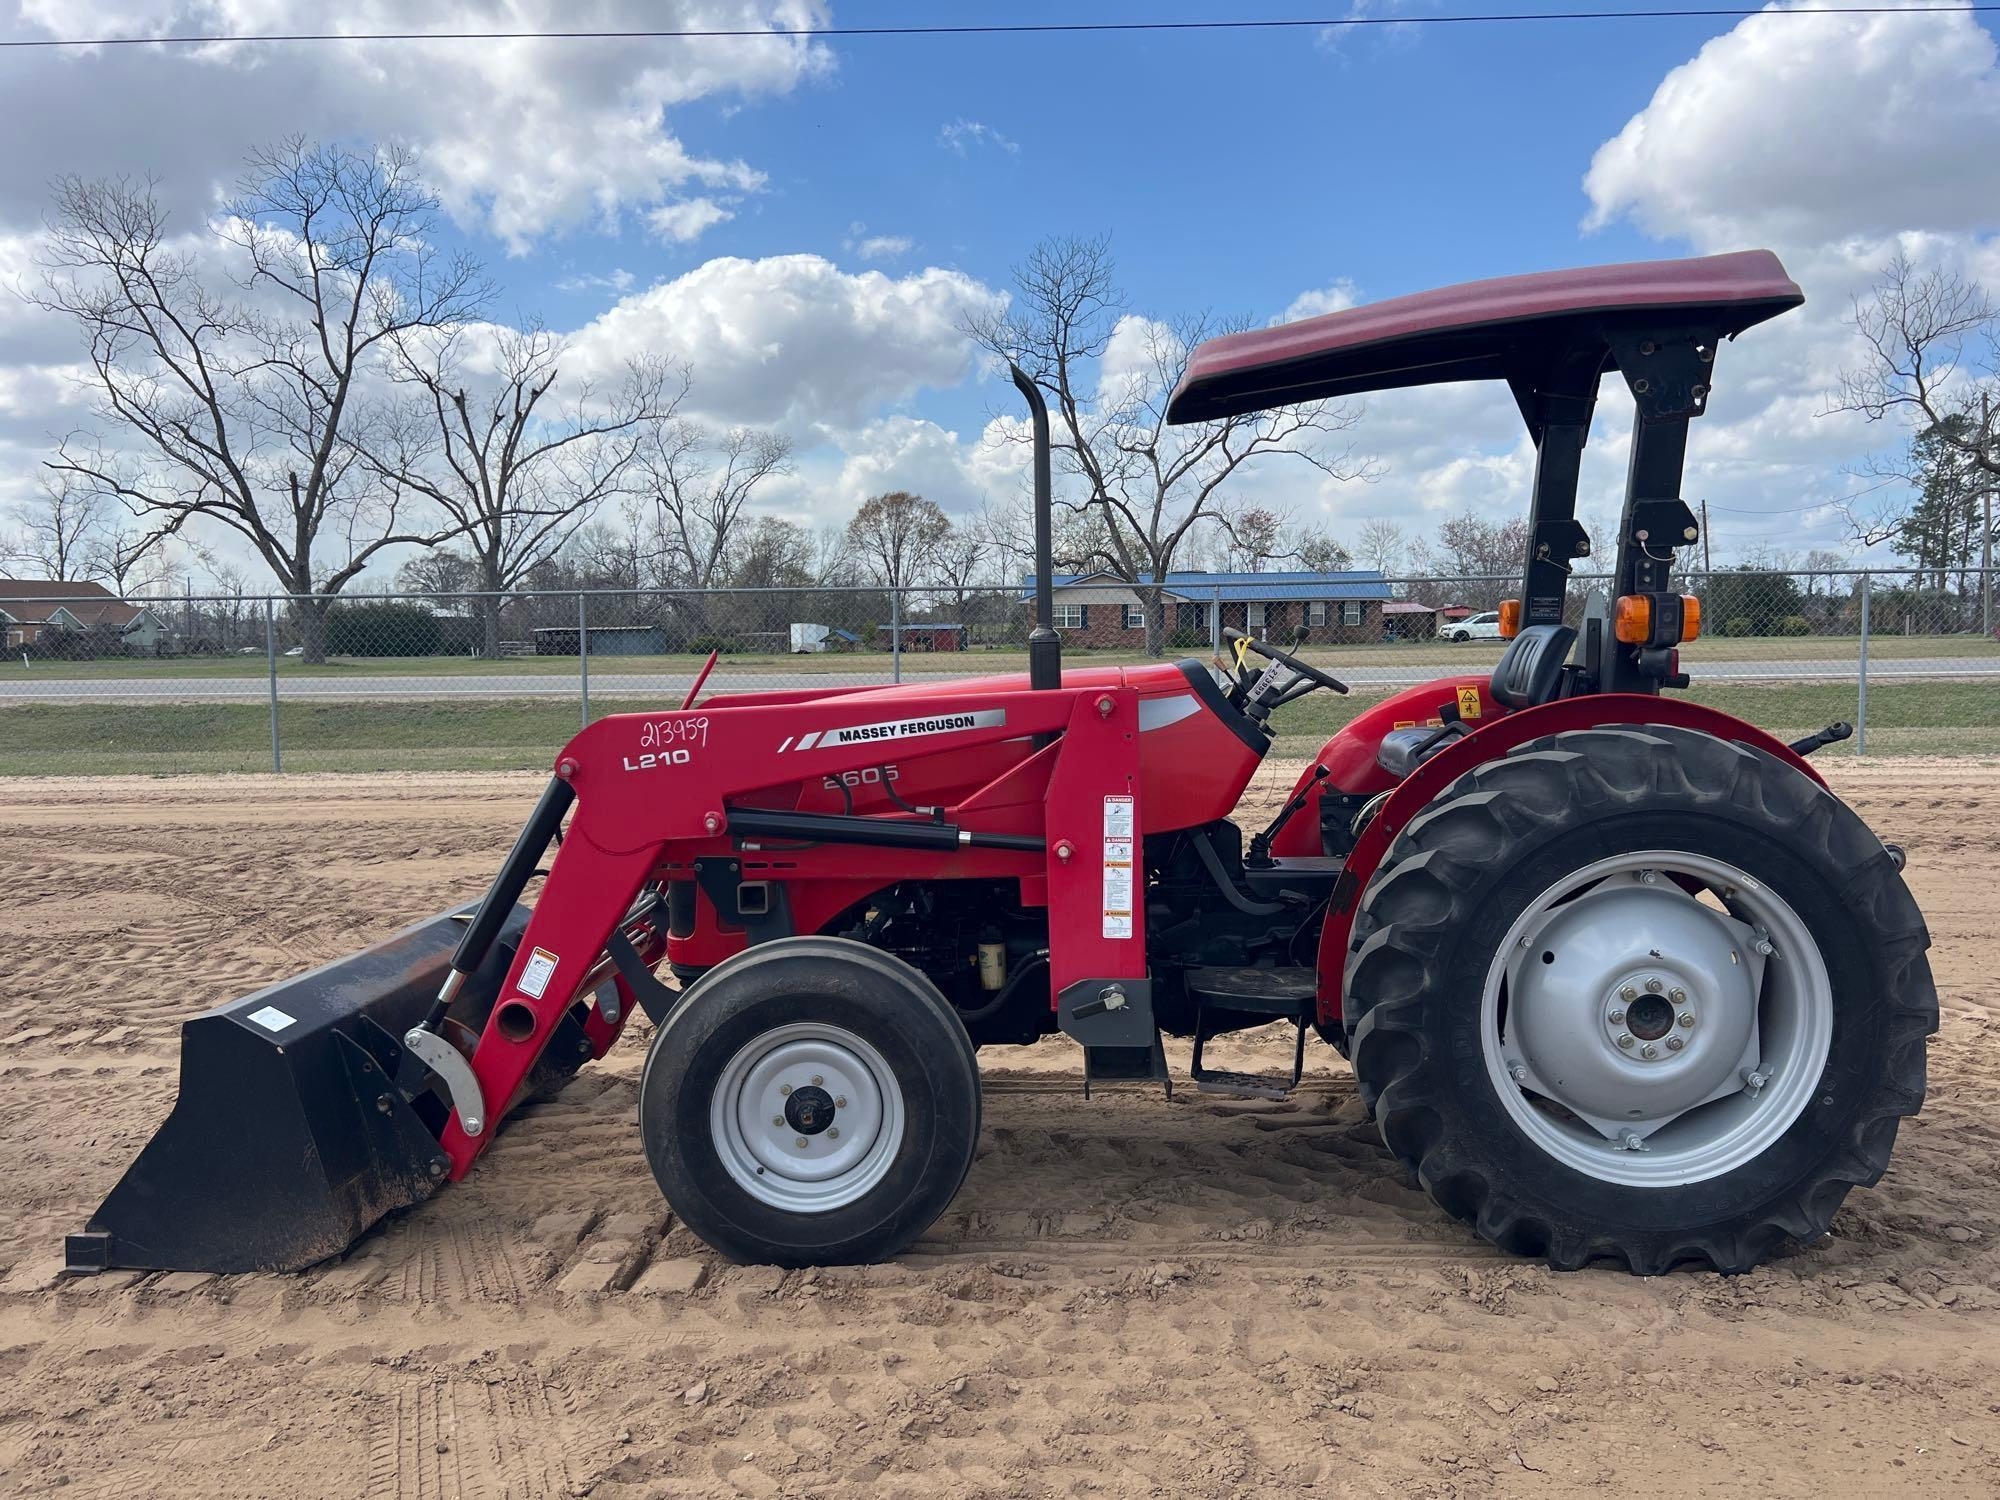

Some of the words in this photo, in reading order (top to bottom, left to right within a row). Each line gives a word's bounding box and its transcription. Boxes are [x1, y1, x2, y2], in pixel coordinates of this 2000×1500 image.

[1255, 669, 1278, 696] 213959
[640, 717, 709, 748] 213959
[839, 725, 897, 742] MASSEY
[900, 715, 975, 735] FERGUSON
[623, 749, 690, 771] L210
